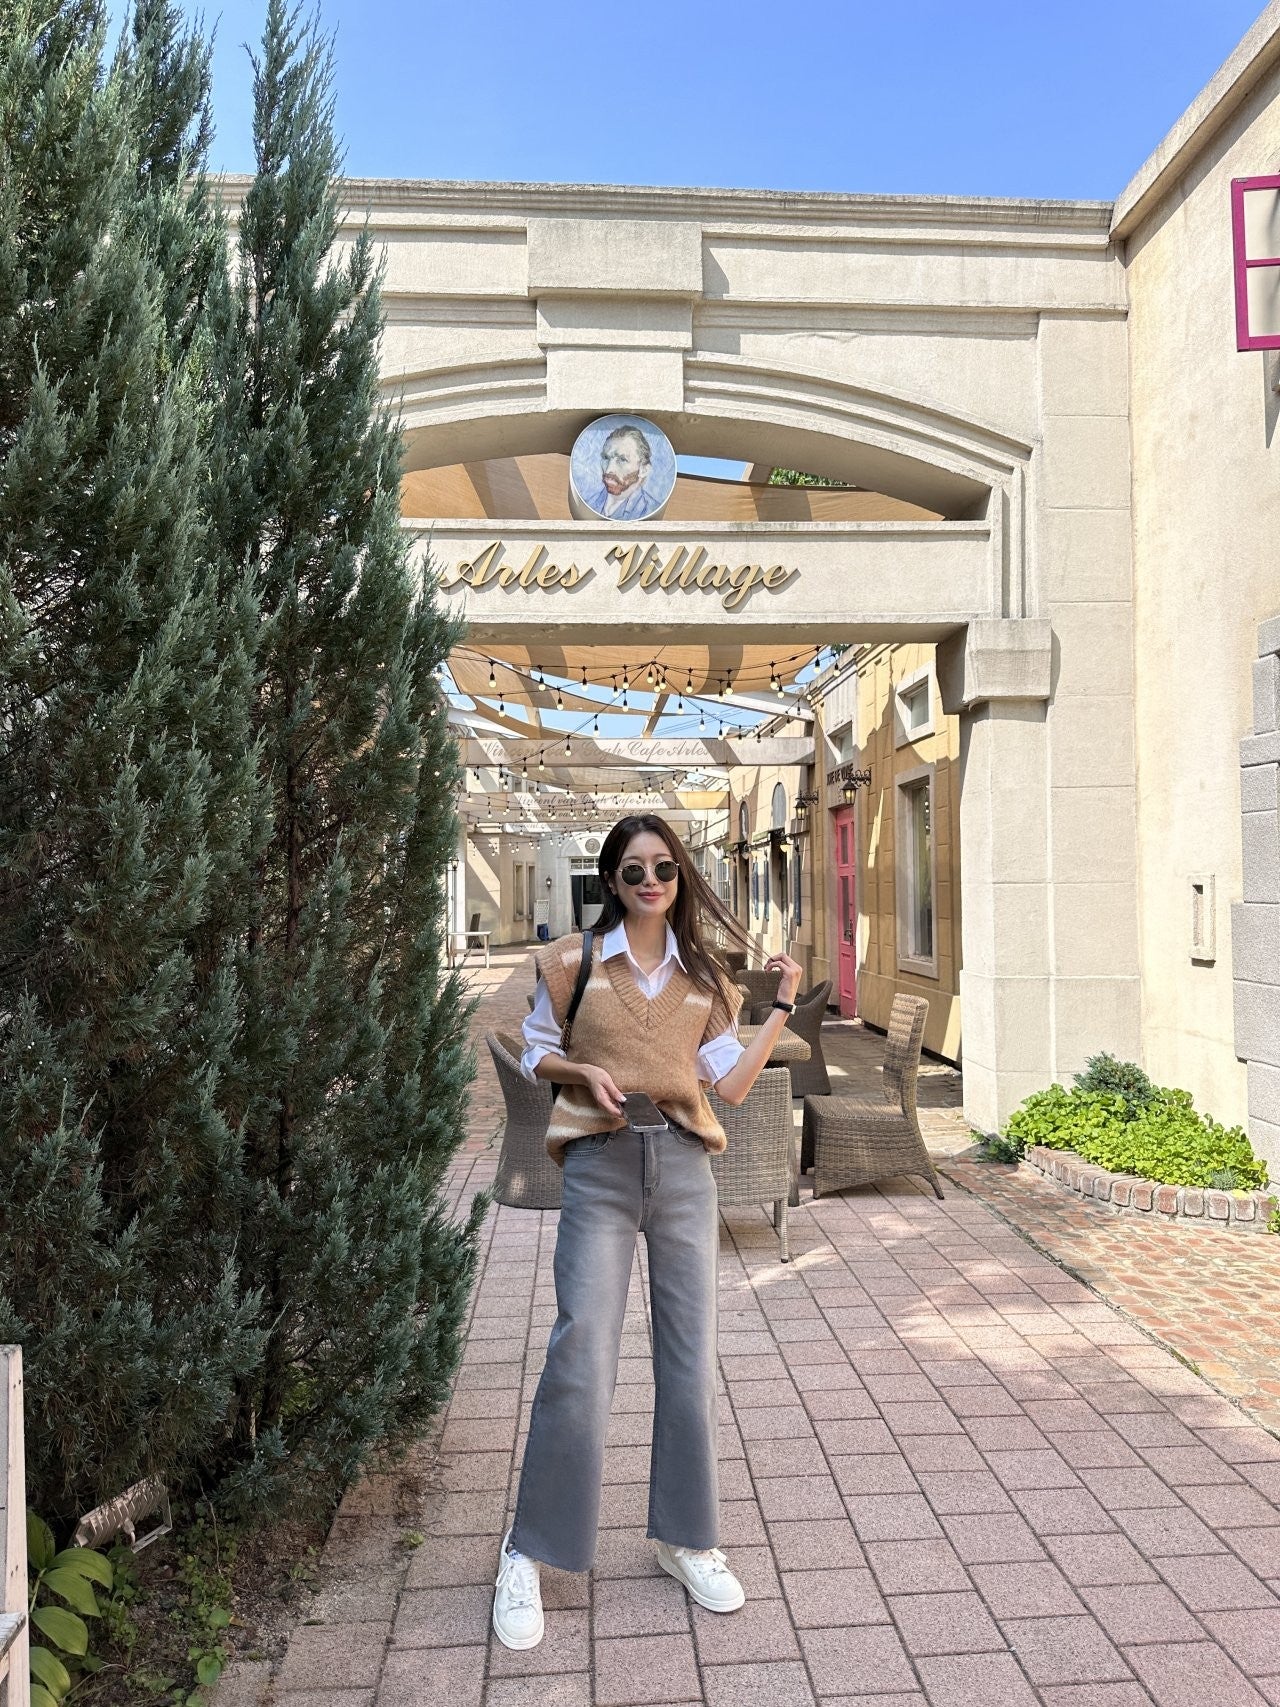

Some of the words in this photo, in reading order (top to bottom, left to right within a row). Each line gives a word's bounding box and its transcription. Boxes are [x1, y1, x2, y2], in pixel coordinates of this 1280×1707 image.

[439, 540, 594, 591] Arles
[607, 541, 797, 610] Village
[627, 739, 665, 762] Cafe
